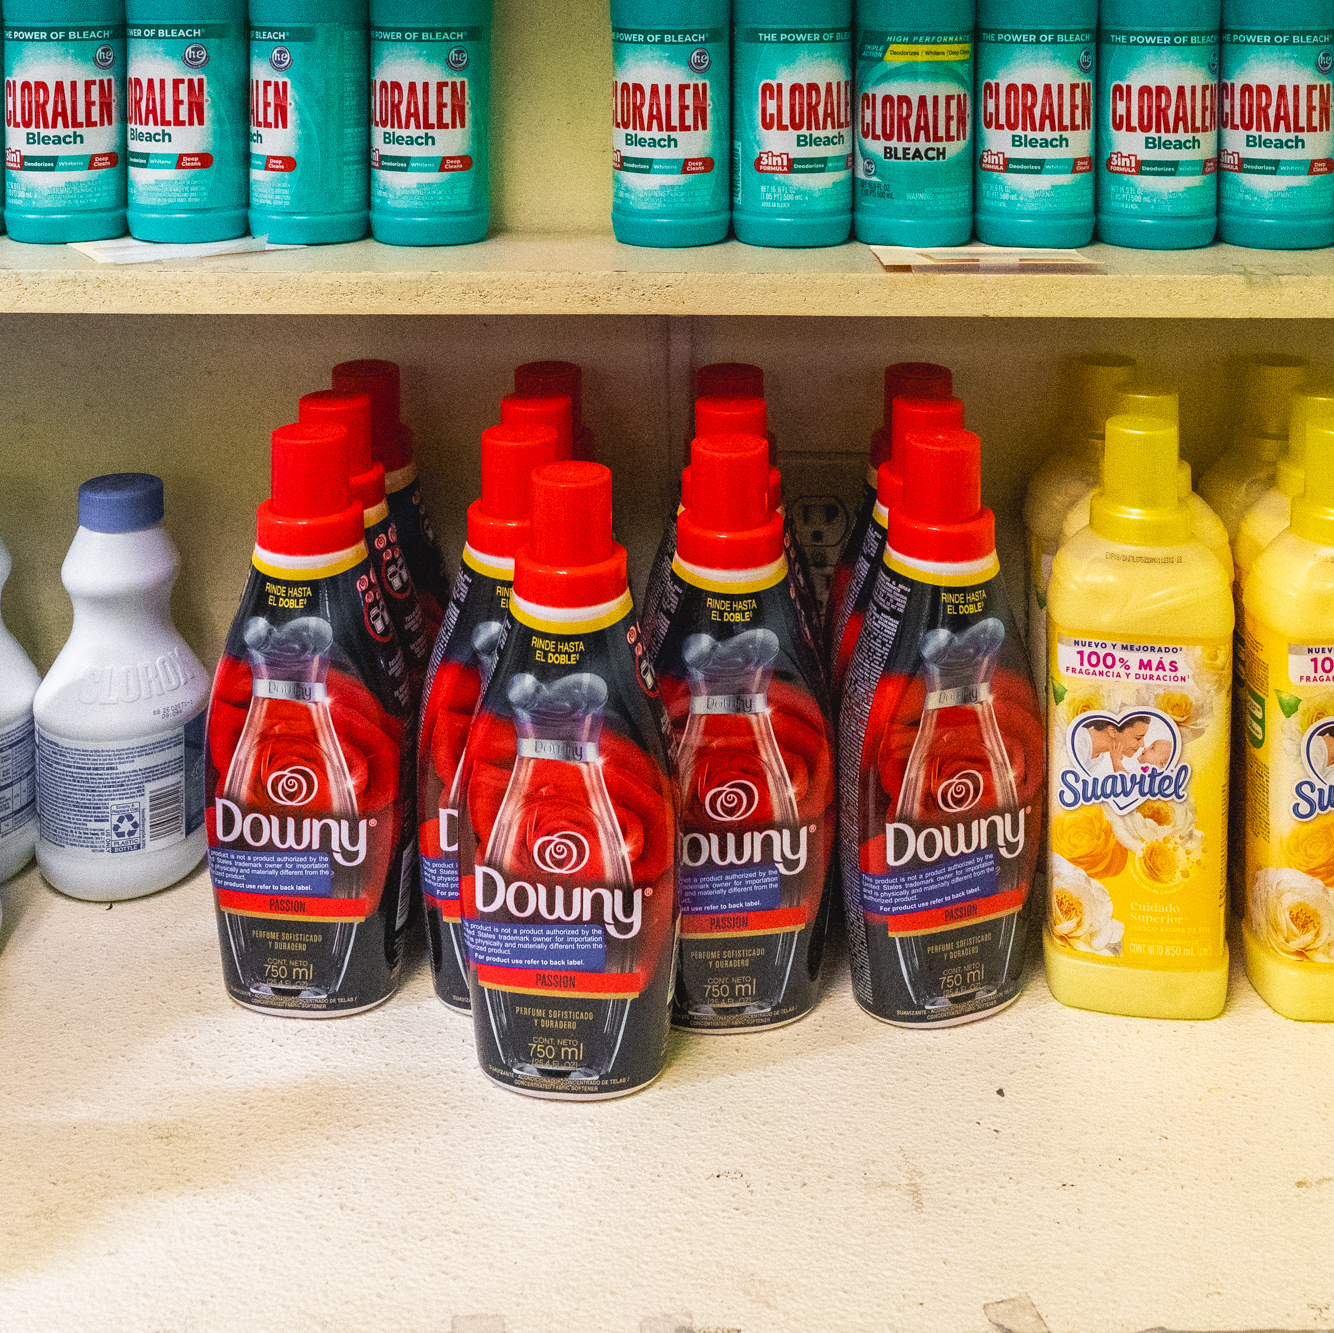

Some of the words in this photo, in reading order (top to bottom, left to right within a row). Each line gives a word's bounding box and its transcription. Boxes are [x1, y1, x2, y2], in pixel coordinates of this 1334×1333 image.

[886, 35, 908, 43] HIGH
[5, 78, 113, 128] CLORALEN
[982, 81, 1091, 132] CLORALEN
[860, 92, 967, 142] CLORALEN
[25, 131, 84, 147] Bleach
[796, 132, 845, 148] Bleach
[1011, 133, 1069, 149] Bleach
[760, 153, 788, 166] 3in1
[883, 145, 946, 162] BLEACH
[266, 582, 286, 597] RINDE
[287, 586, 312, 597] HASTA
[268, 596, 278, 606] EL
[1073, 639, 1108, 650] NUEVO
[1111, 642, 1117, 651] Y
[1076, 650, 1131, 671] 100%
[1138, 655, 1179, 673] MÁS
[1066, 667, 1124, 679] FRAGANCIA
[1125, 671, 1132, 679] Y
[1059, 764, 1189, 810] Suavitel
[215, 797, 367, 866] Downy
[886, 808, 1025, 866] Downy
[475, 865, 642, 939] Downy
[470, 923, 491, 932] product
[486, 955, 510, 965] product
[536, 974, 576, 988] PASSION
[516, 1006, 546, 1018] PERFUME
[549, 1010, 593, 1020] SOFISTICADO
[533, 1036, 555, 1044] CONT.
[528, 1043, 555, 1057] 750
[561, 1043, 583, 1060] ml
